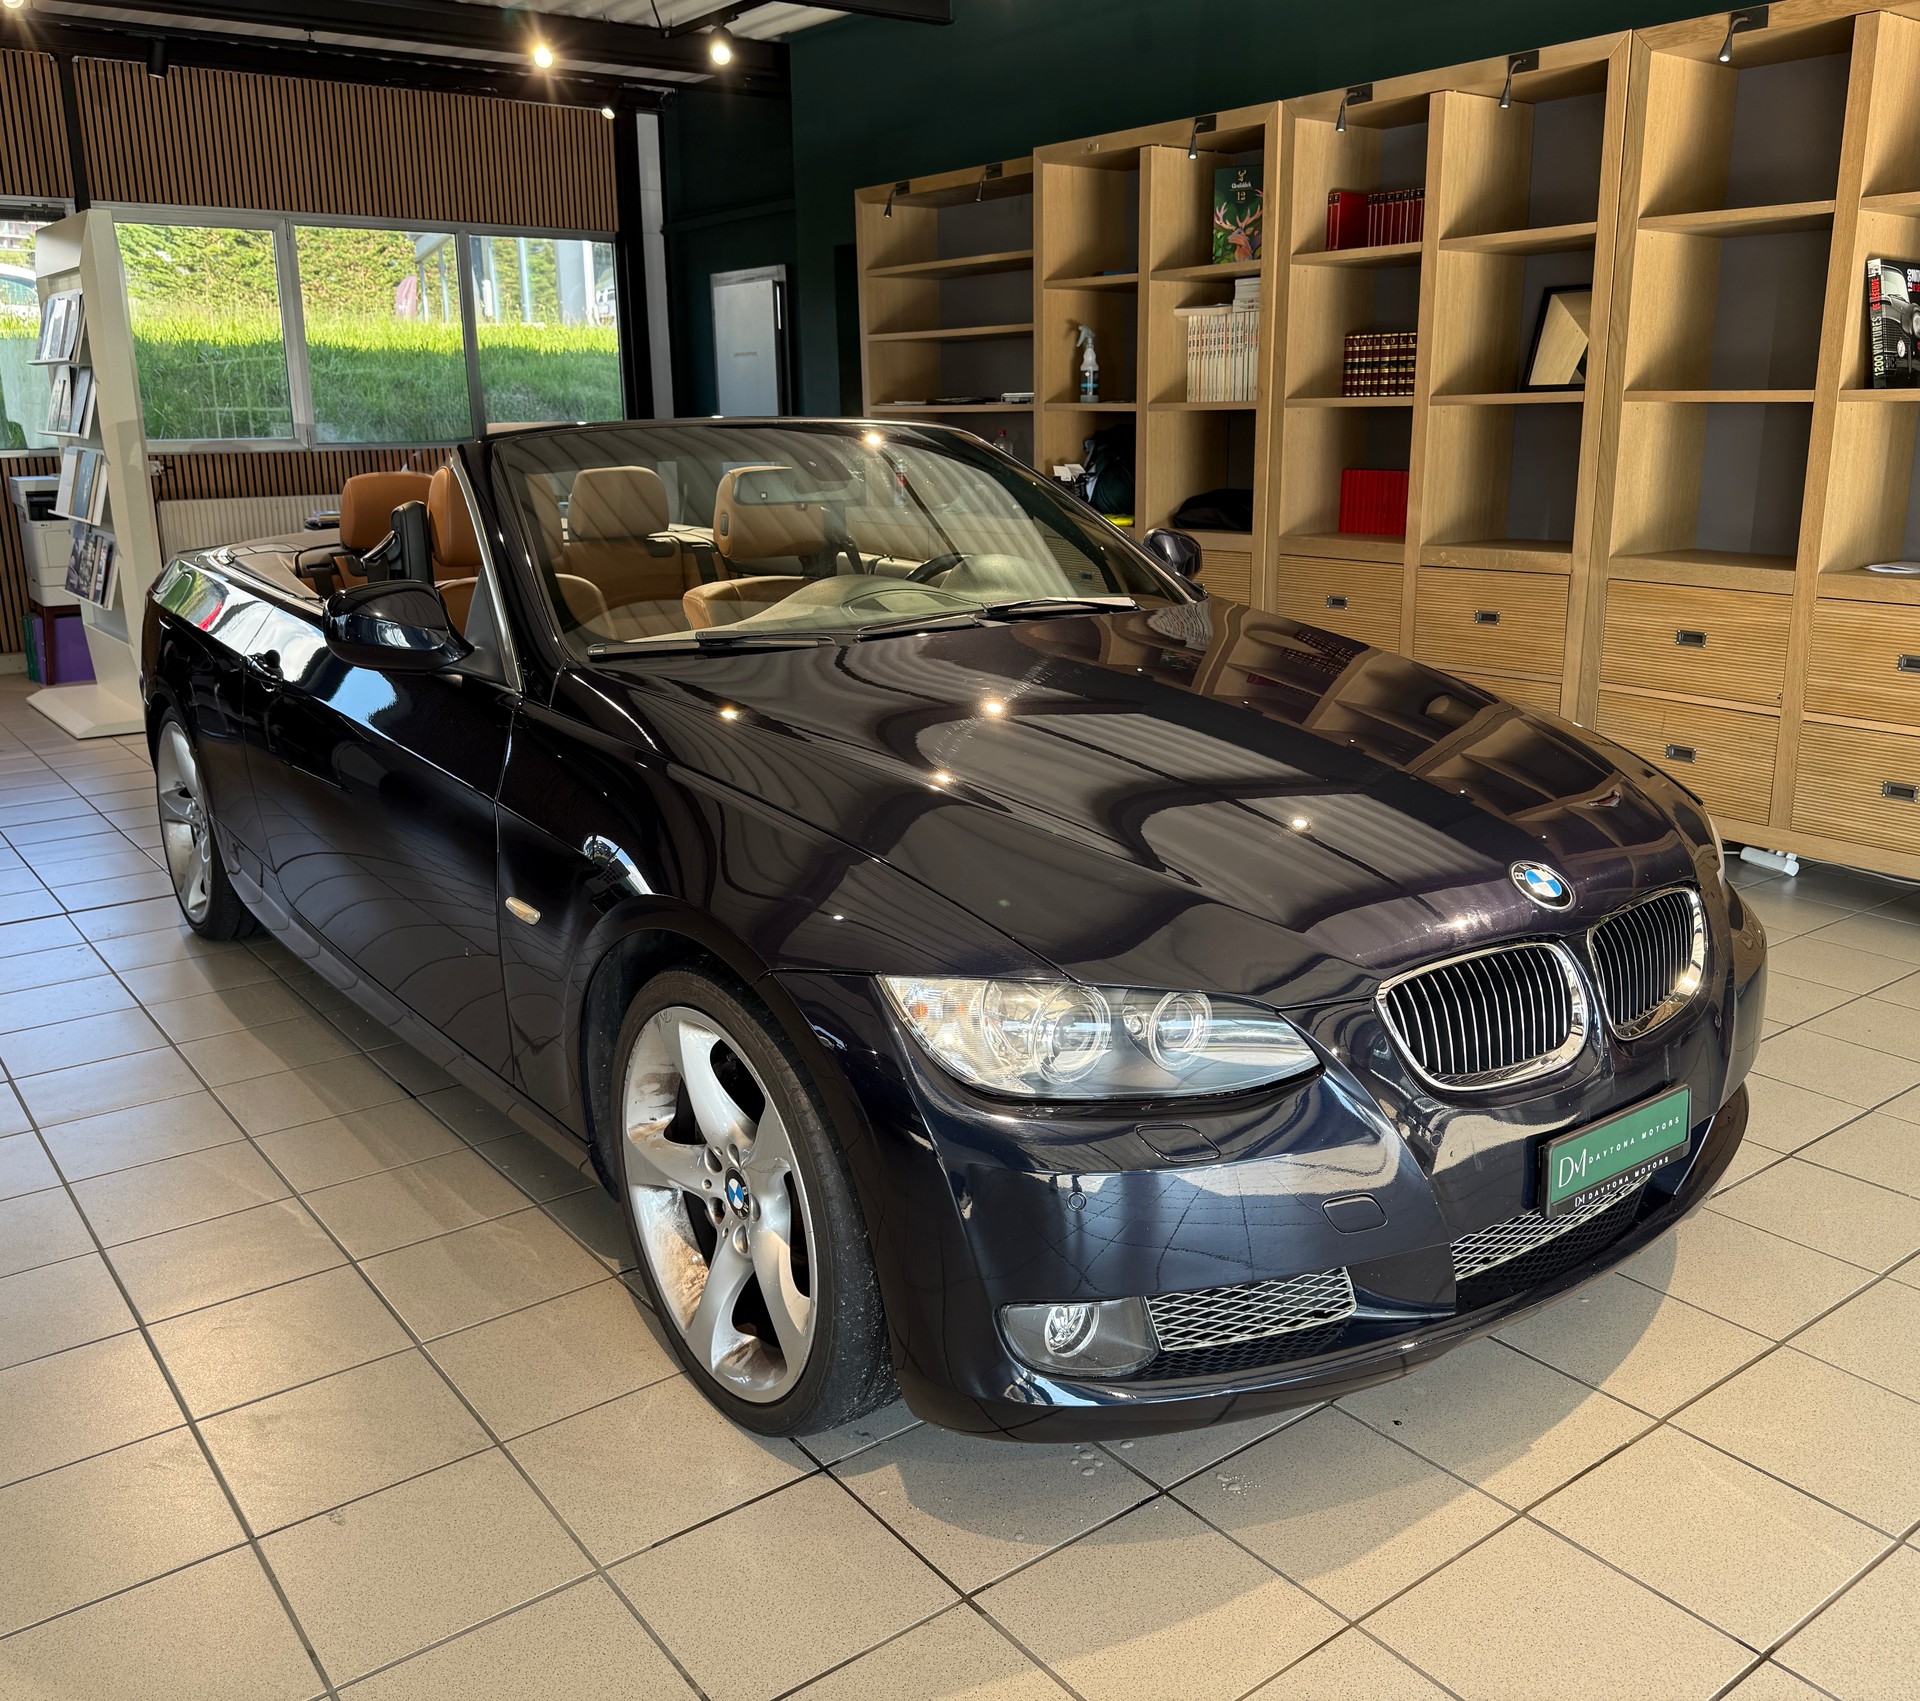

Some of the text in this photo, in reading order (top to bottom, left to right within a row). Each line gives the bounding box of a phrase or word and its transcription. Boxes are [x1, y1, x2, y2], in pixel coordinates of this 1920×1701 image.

[1237, 191, 1245, 200] 12
[1872, 316, 1883, 354] VOITURES
[1874, 355, 1885, 376] 1200
[1588, 1137, 1635, 1164] DAYTONA
[1641, 1116, 1680, 1140] MOTORS
[1588, 1175, 1629, 1200] DAYTONA
[1634, 1156, 1669, 1178] MOTORS
